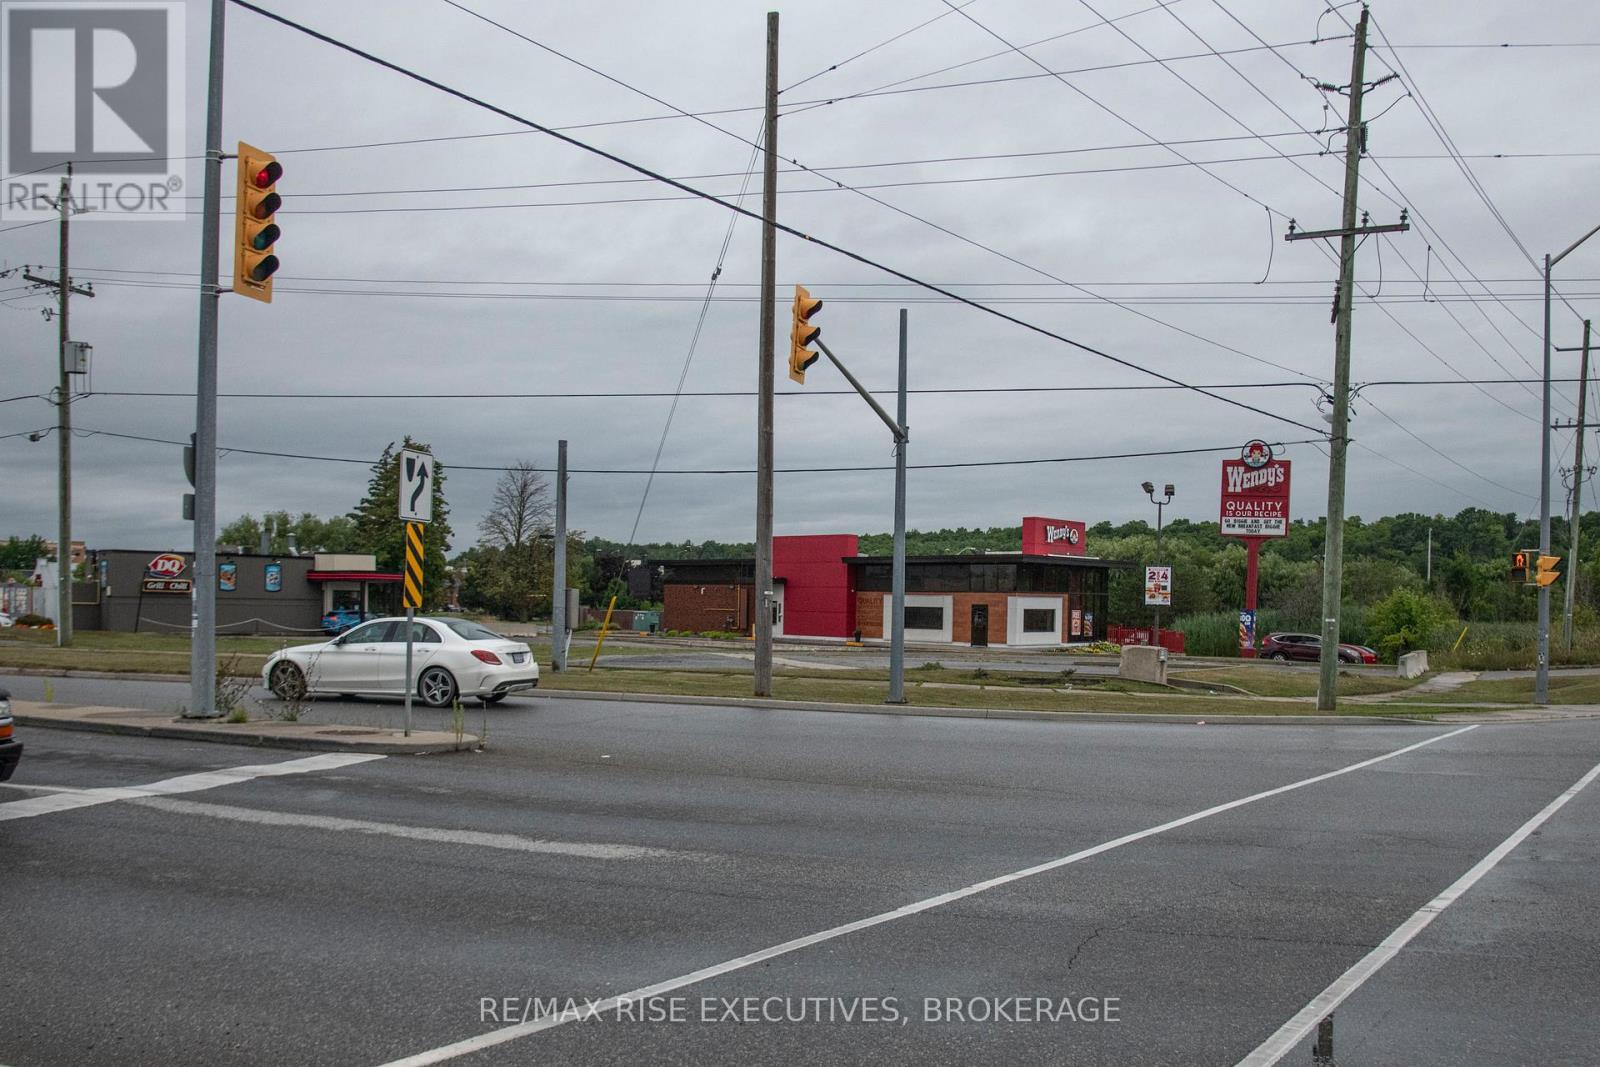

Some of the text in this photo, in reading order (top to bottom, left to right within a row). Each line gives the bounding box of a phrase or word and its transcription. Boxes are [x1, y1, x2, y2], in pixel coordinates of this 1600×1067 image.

[1226, 501, 1282, 511] QUALITY
[157, 559, 181, 572] DQ
[1149, 571, 1156, 580] 2
[1161, 571, 1168, 580] 4
